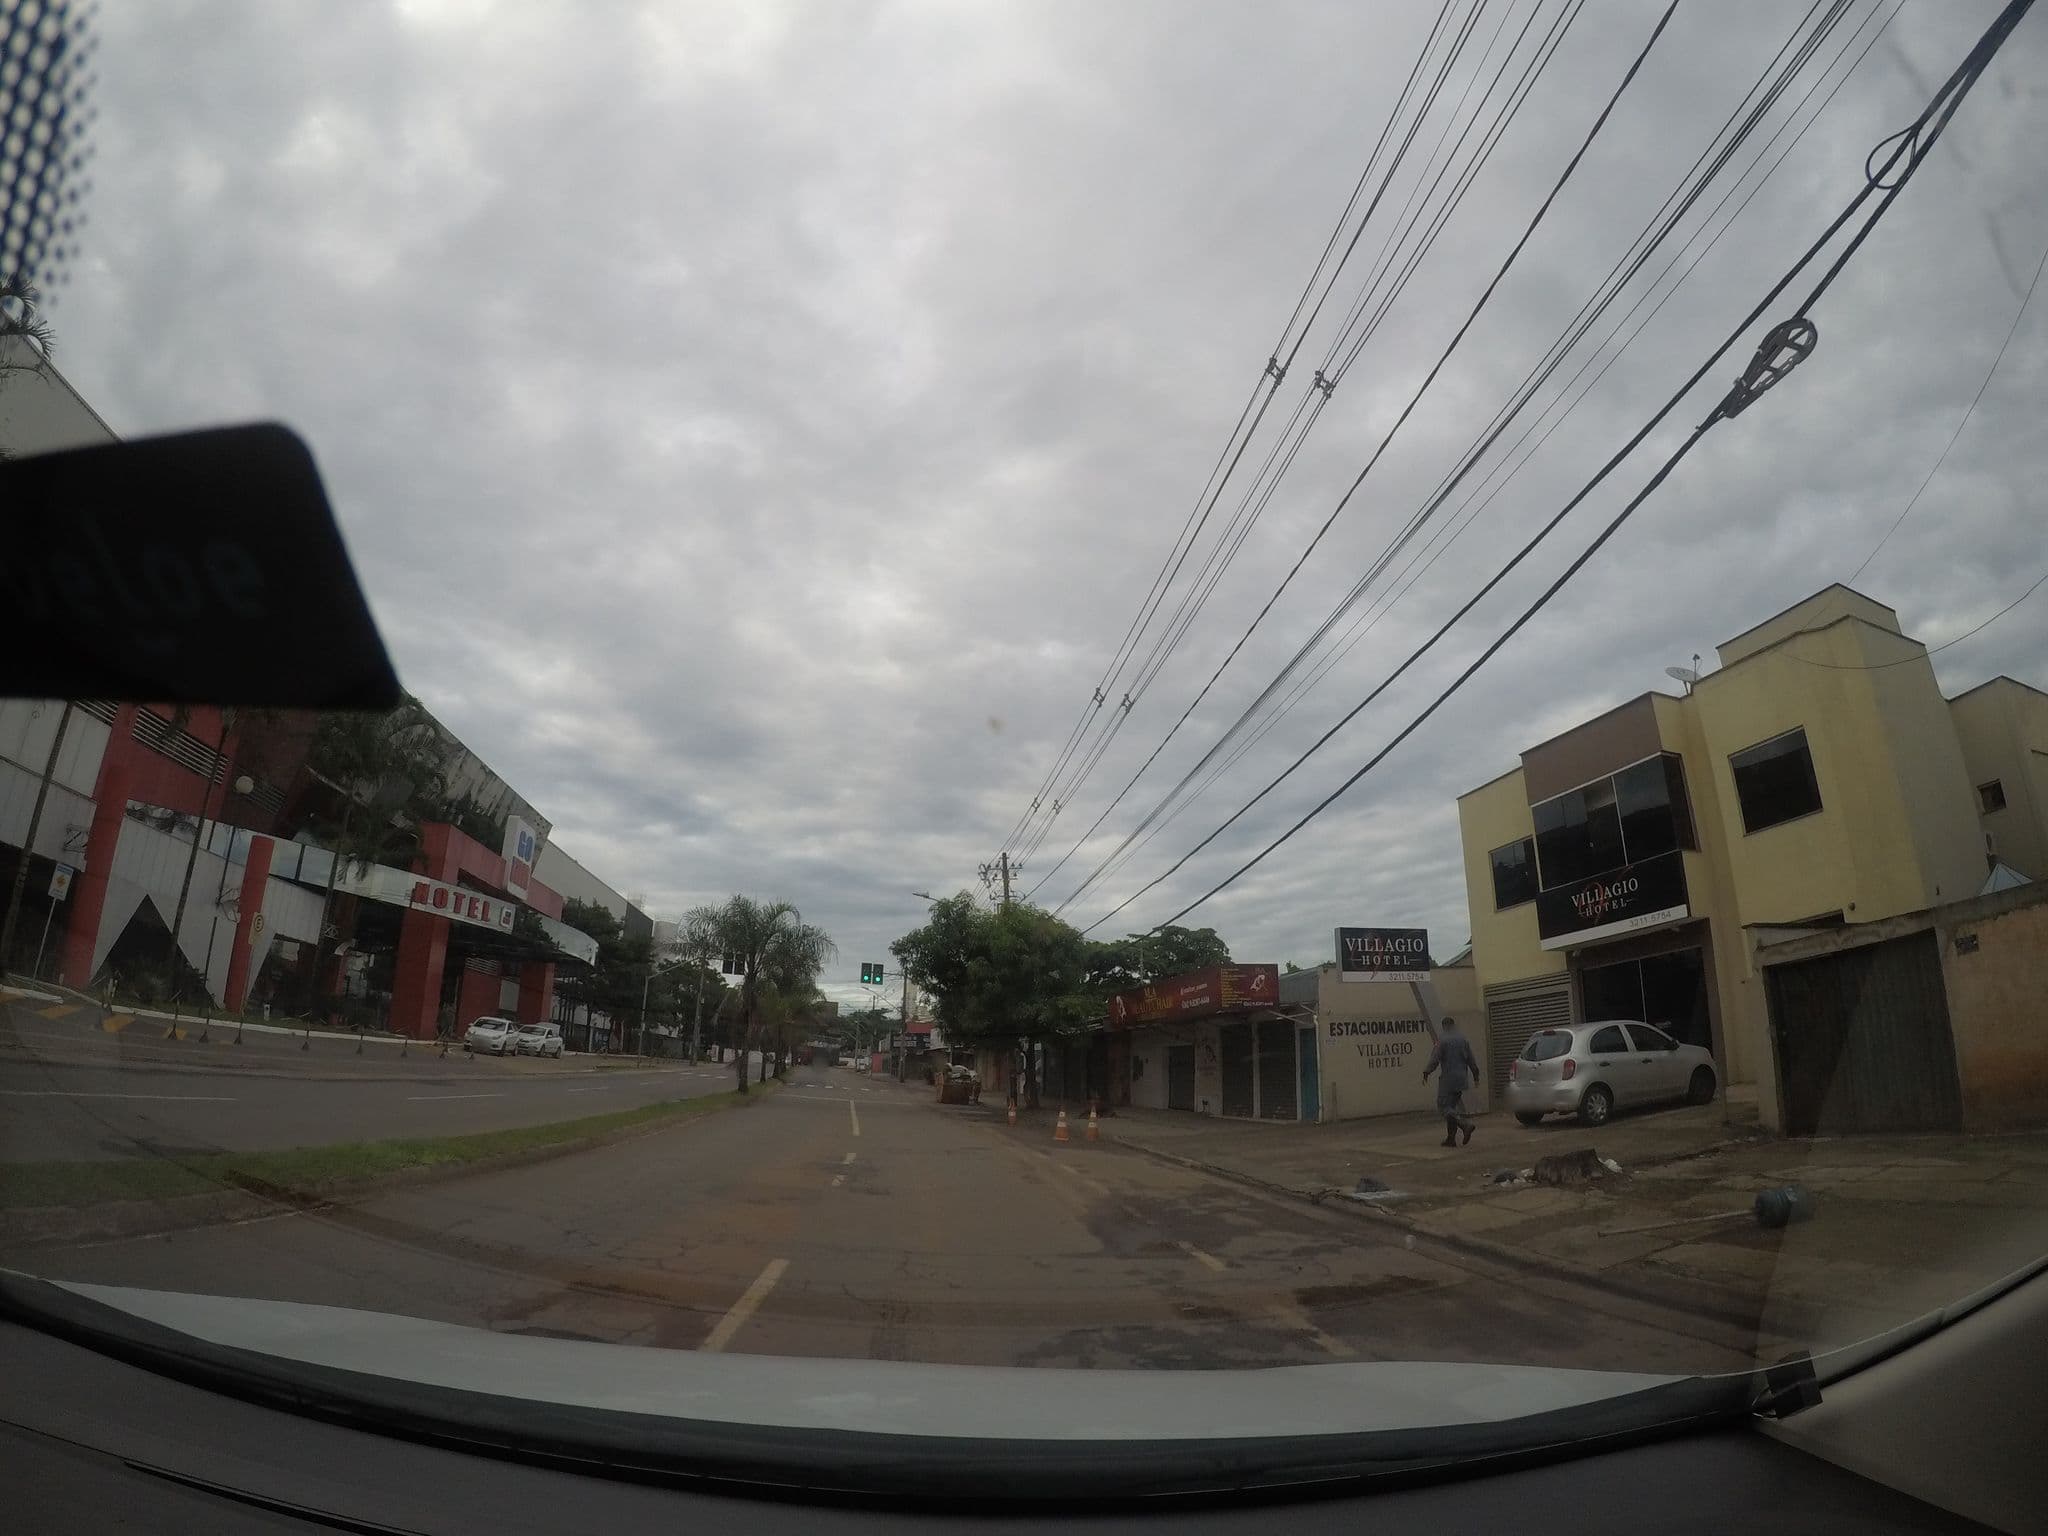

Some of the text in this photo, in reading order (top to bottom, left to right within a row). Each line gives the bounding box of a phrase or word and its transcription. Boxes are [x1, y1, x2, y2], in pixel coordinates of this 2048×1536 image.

[1571, 877, 1639, 907] VILLAGIO
[411, 881, 491, 922] HOTEL
[1585, 899, 1627, 917] HOTEL
[1345, 937, 1424, 952] VILLAGIO
[1362, 955, 1410, 966] HOTEL
[1357, 1042, 1413, 1057] VILLAGIO
[1368, 1056, 1403, 1069] HOTEL
